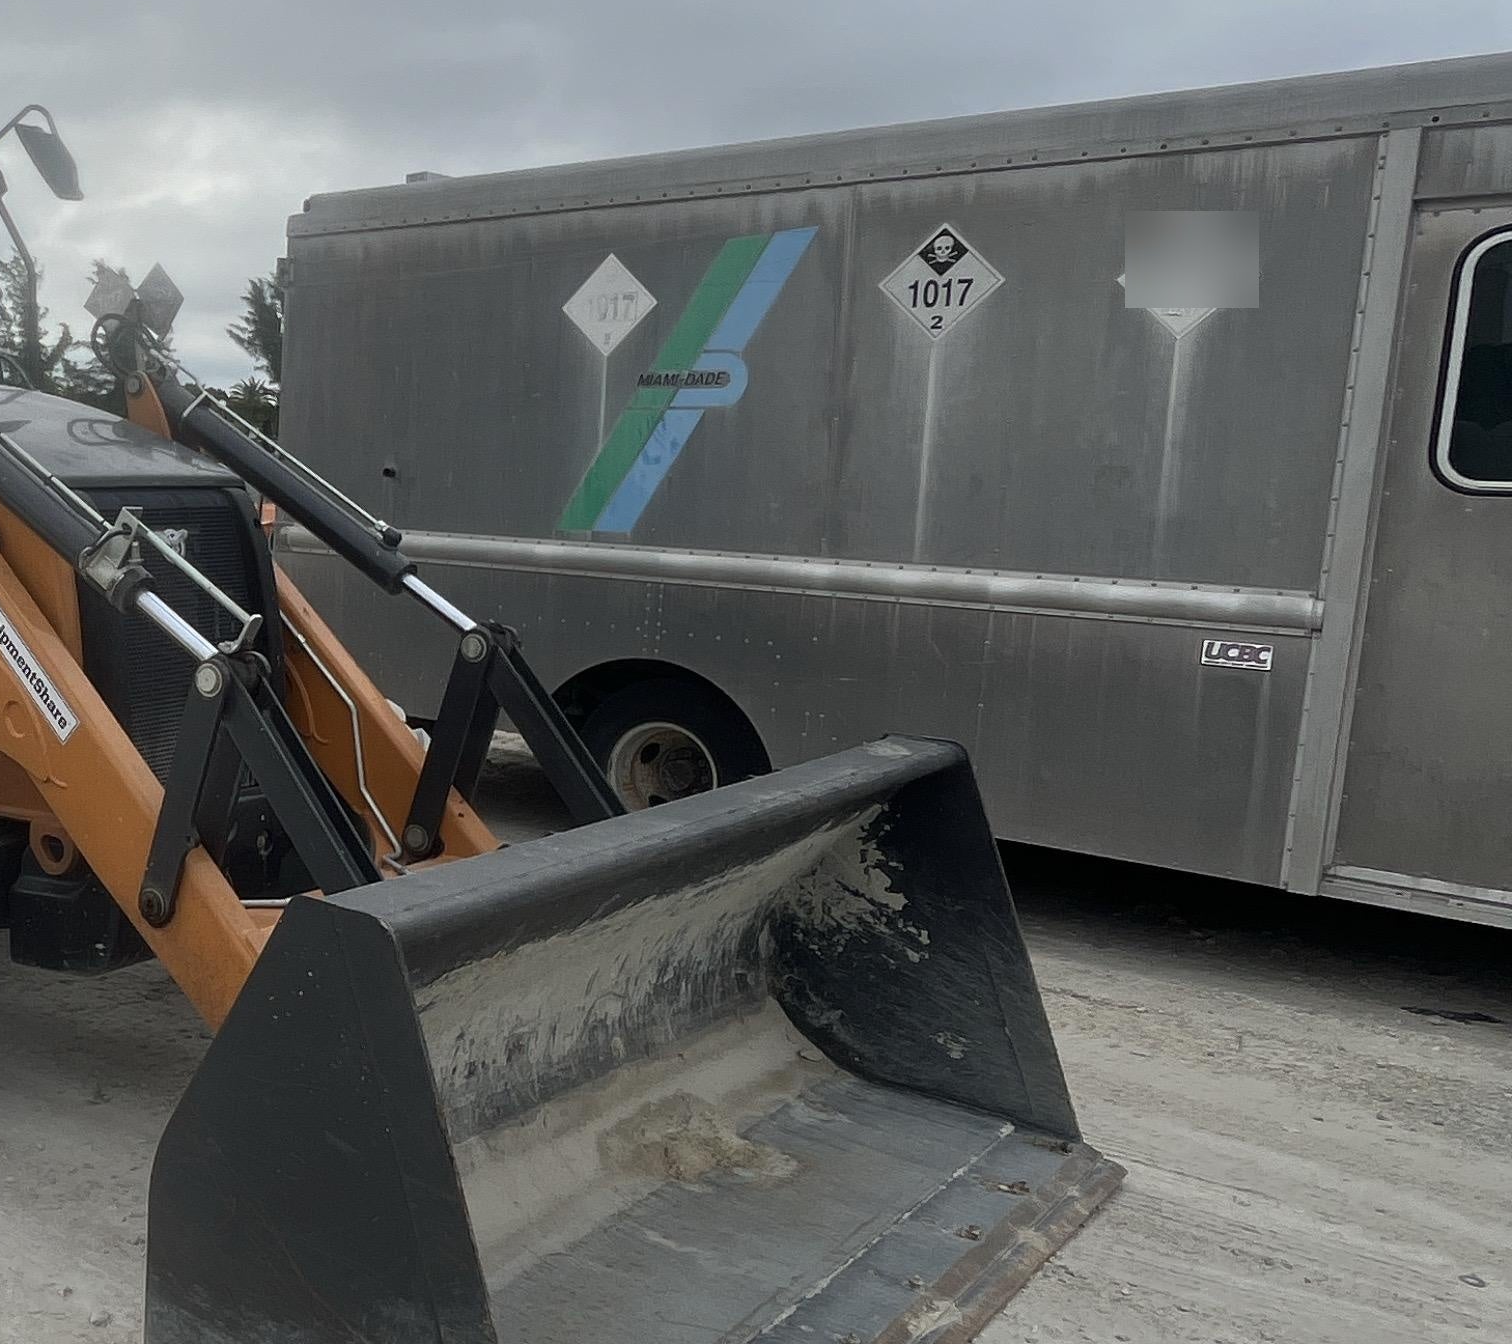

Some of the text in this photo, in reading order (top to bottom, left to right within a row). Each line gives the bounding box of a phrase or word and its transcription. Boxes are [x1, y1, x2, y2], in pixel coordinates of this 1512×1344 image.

[909, 277, 975, 308] 1017
[929, 315, 944, 330] 2
[637, 371, 727, 387] MIAMI-DADE
